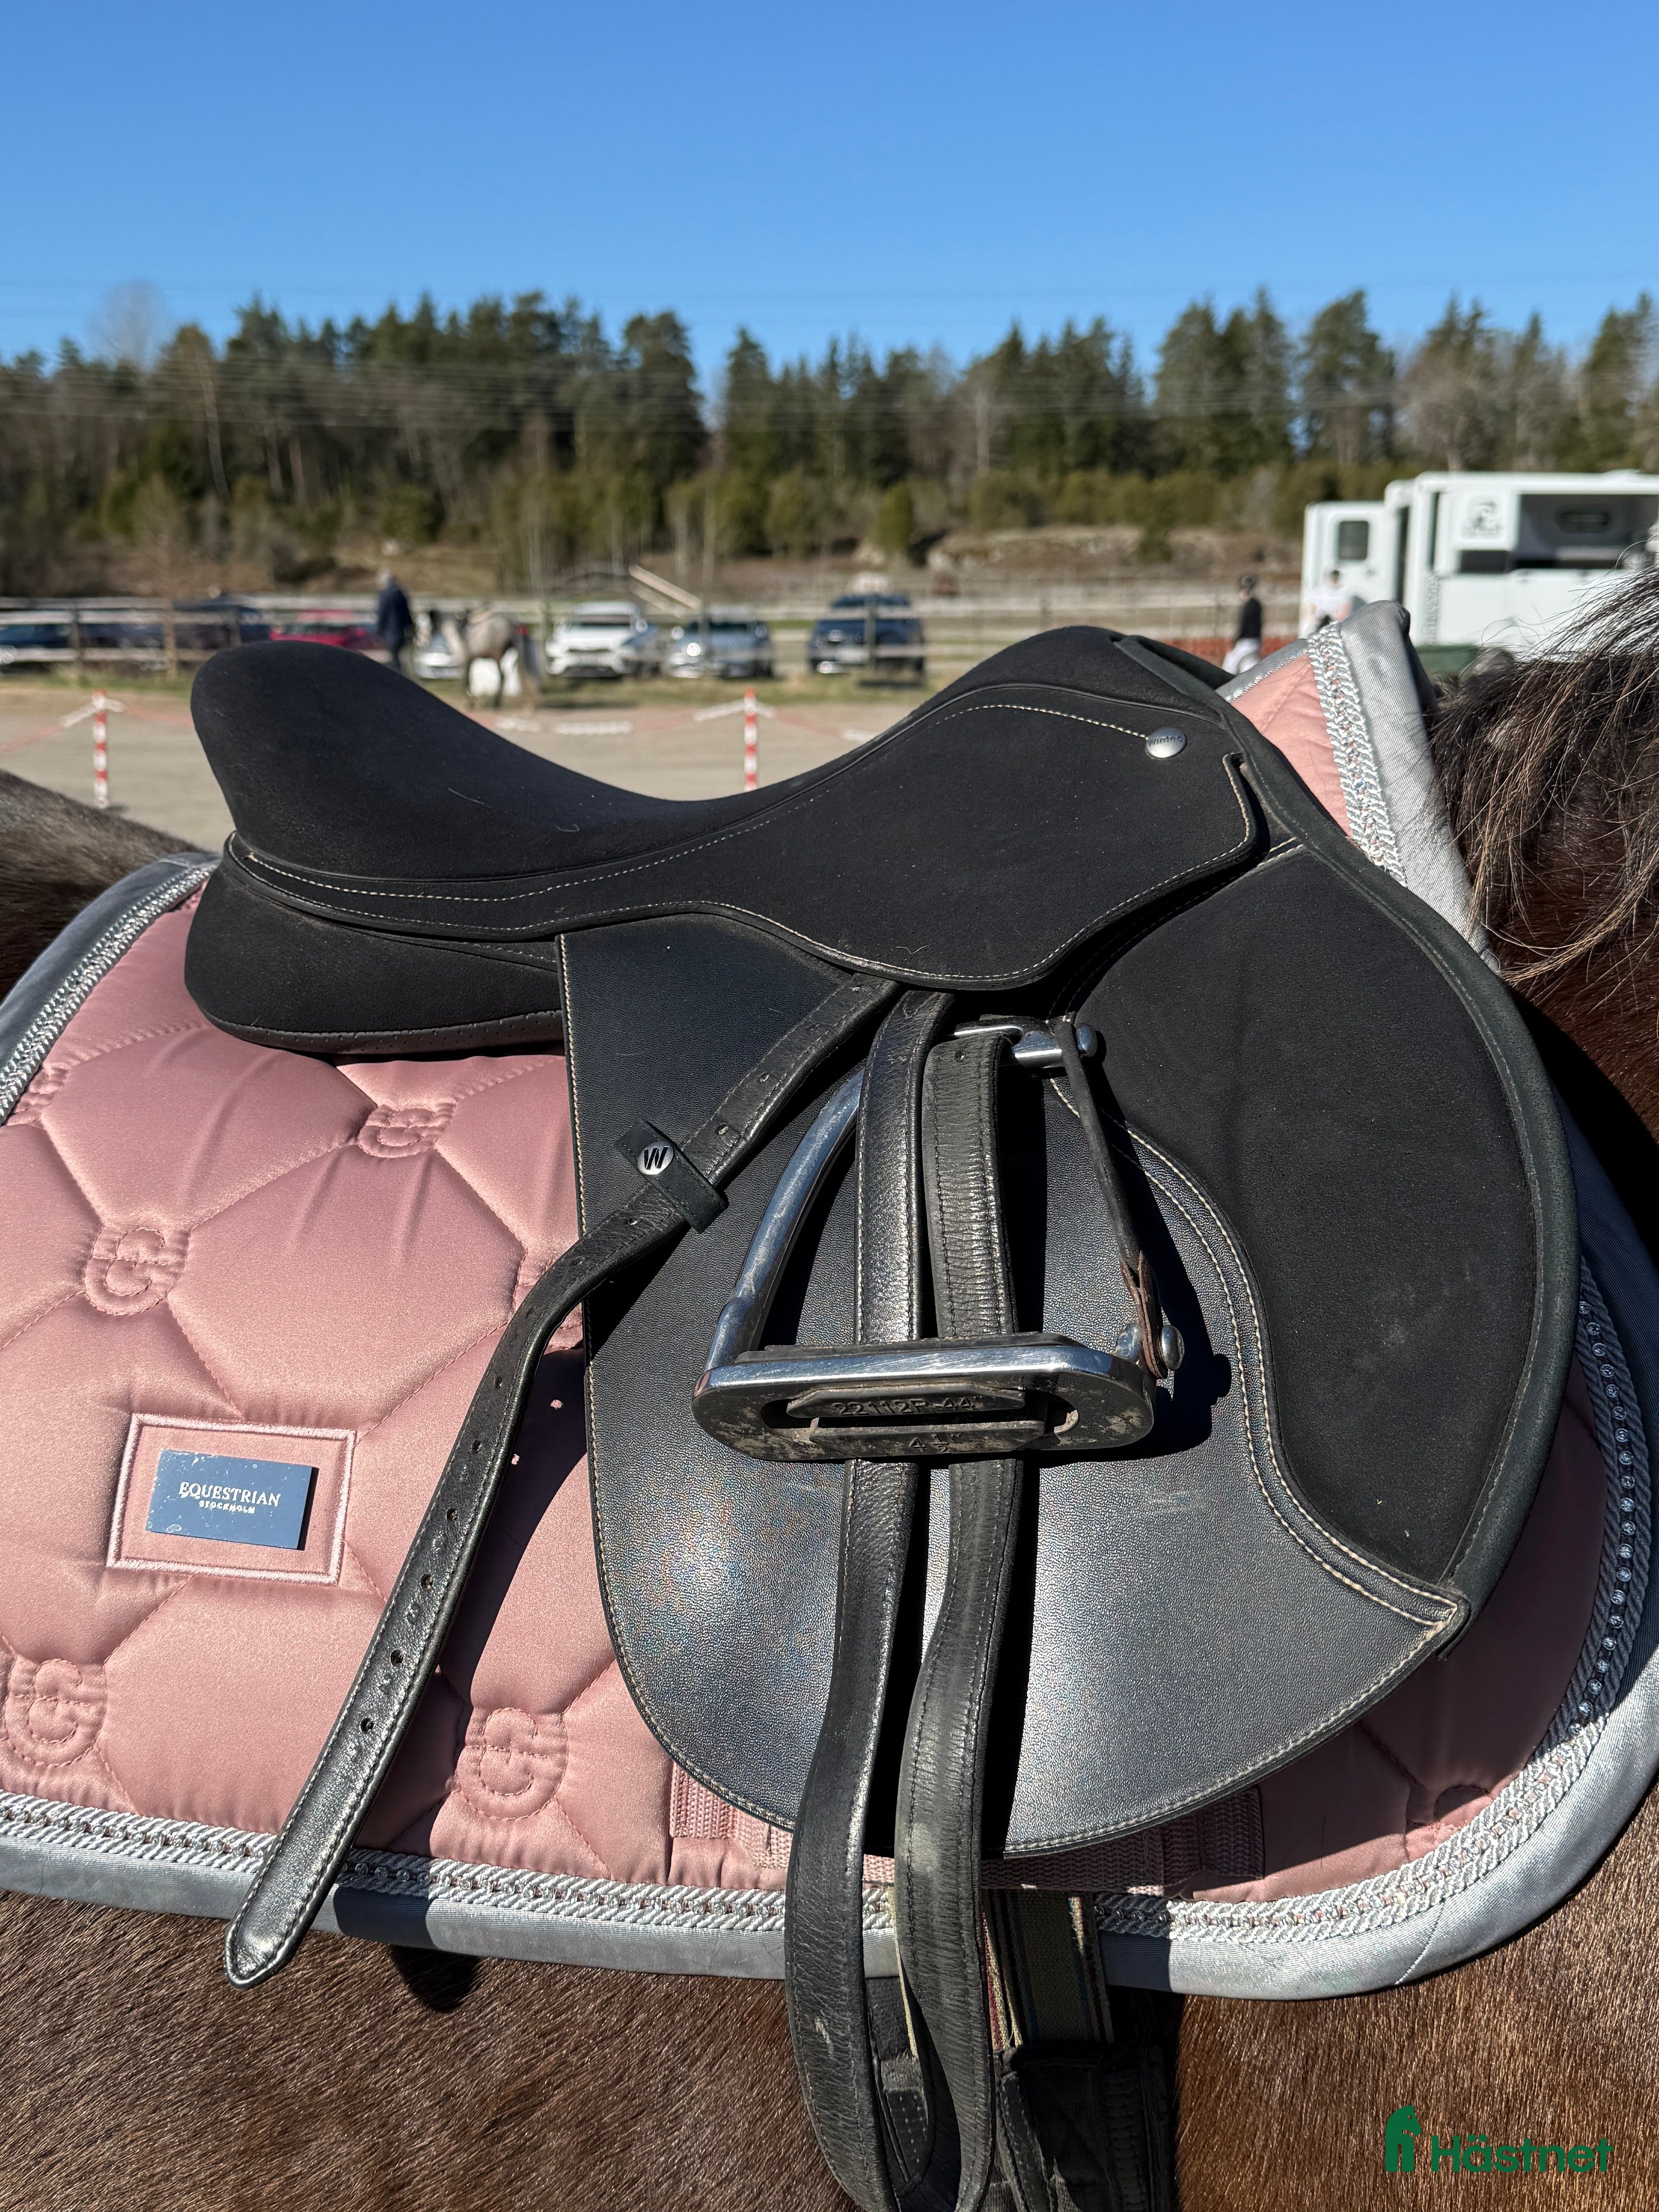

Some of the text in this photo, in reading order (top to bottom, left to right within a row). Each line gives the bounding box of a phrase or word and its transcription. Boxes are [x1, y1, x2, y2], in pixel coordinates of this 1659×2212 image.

[1147, 735, 1182, 747] Wintec
[643, 1146, 670, 1170] W
[178, 1481, 281, 1508] EQUESTRIAN
[198, 1499, 256, 1515] STOCKHOLM
